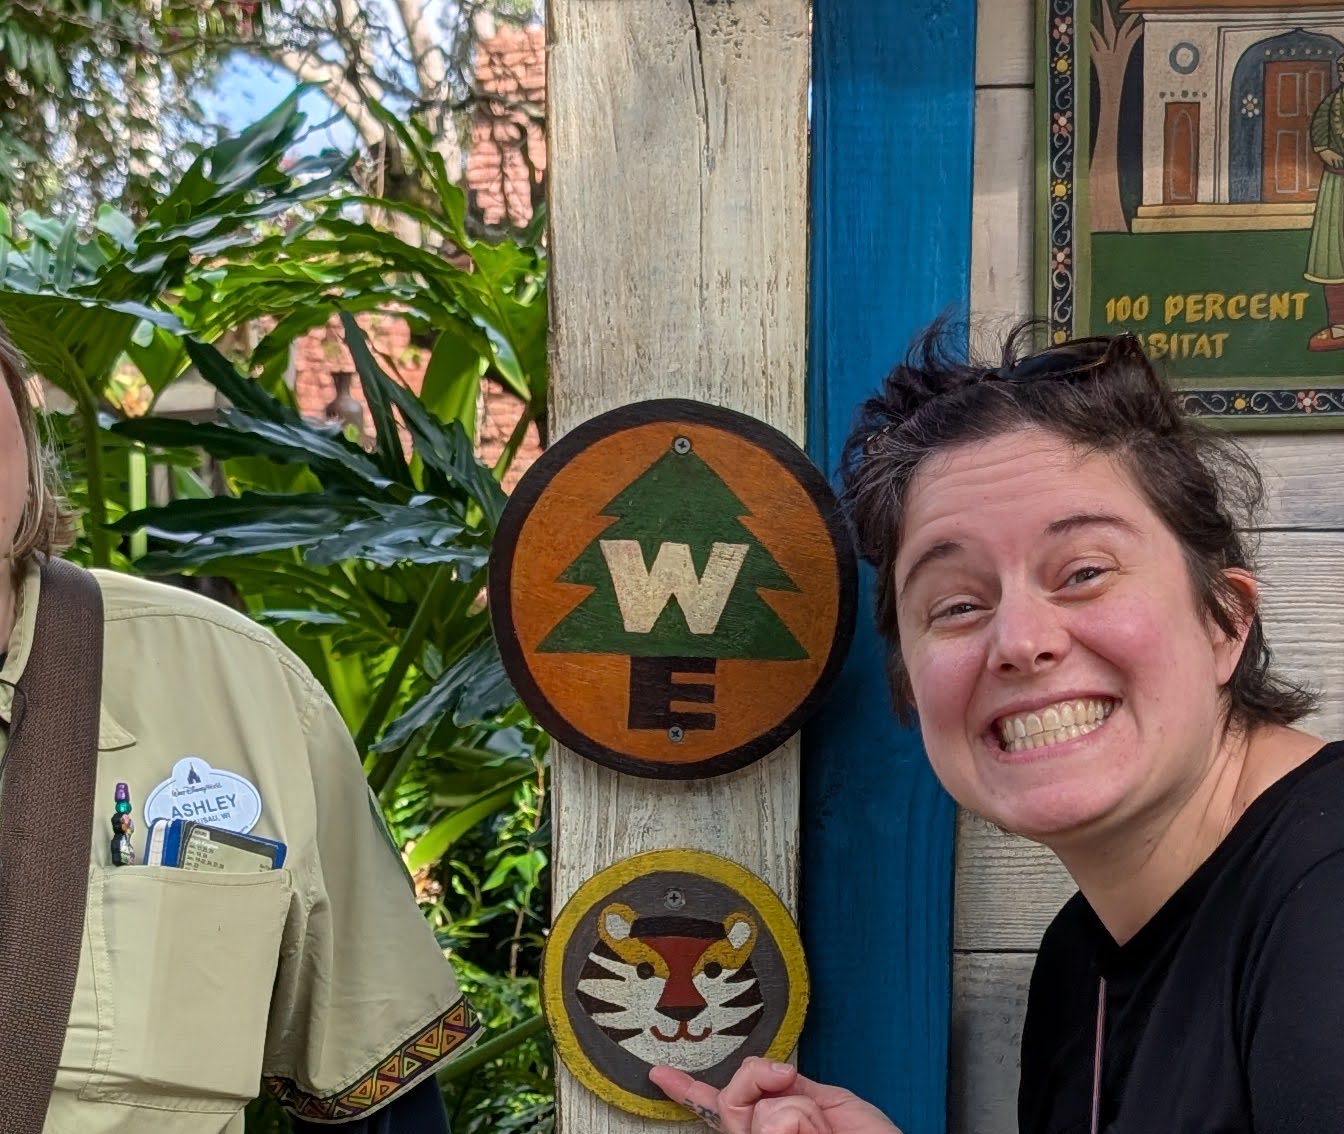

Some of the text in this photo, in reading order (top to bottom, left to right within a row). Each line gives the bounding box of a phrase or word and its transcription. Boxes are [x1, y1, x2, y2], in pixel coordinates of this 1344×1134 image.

[1105, 292, 1310, 326] 100 PERCENT
[1138, 332, 1230, 359] BITAT
[598, 538, 750, 636] W
[171, 793, 236, 818] ASHLEY
